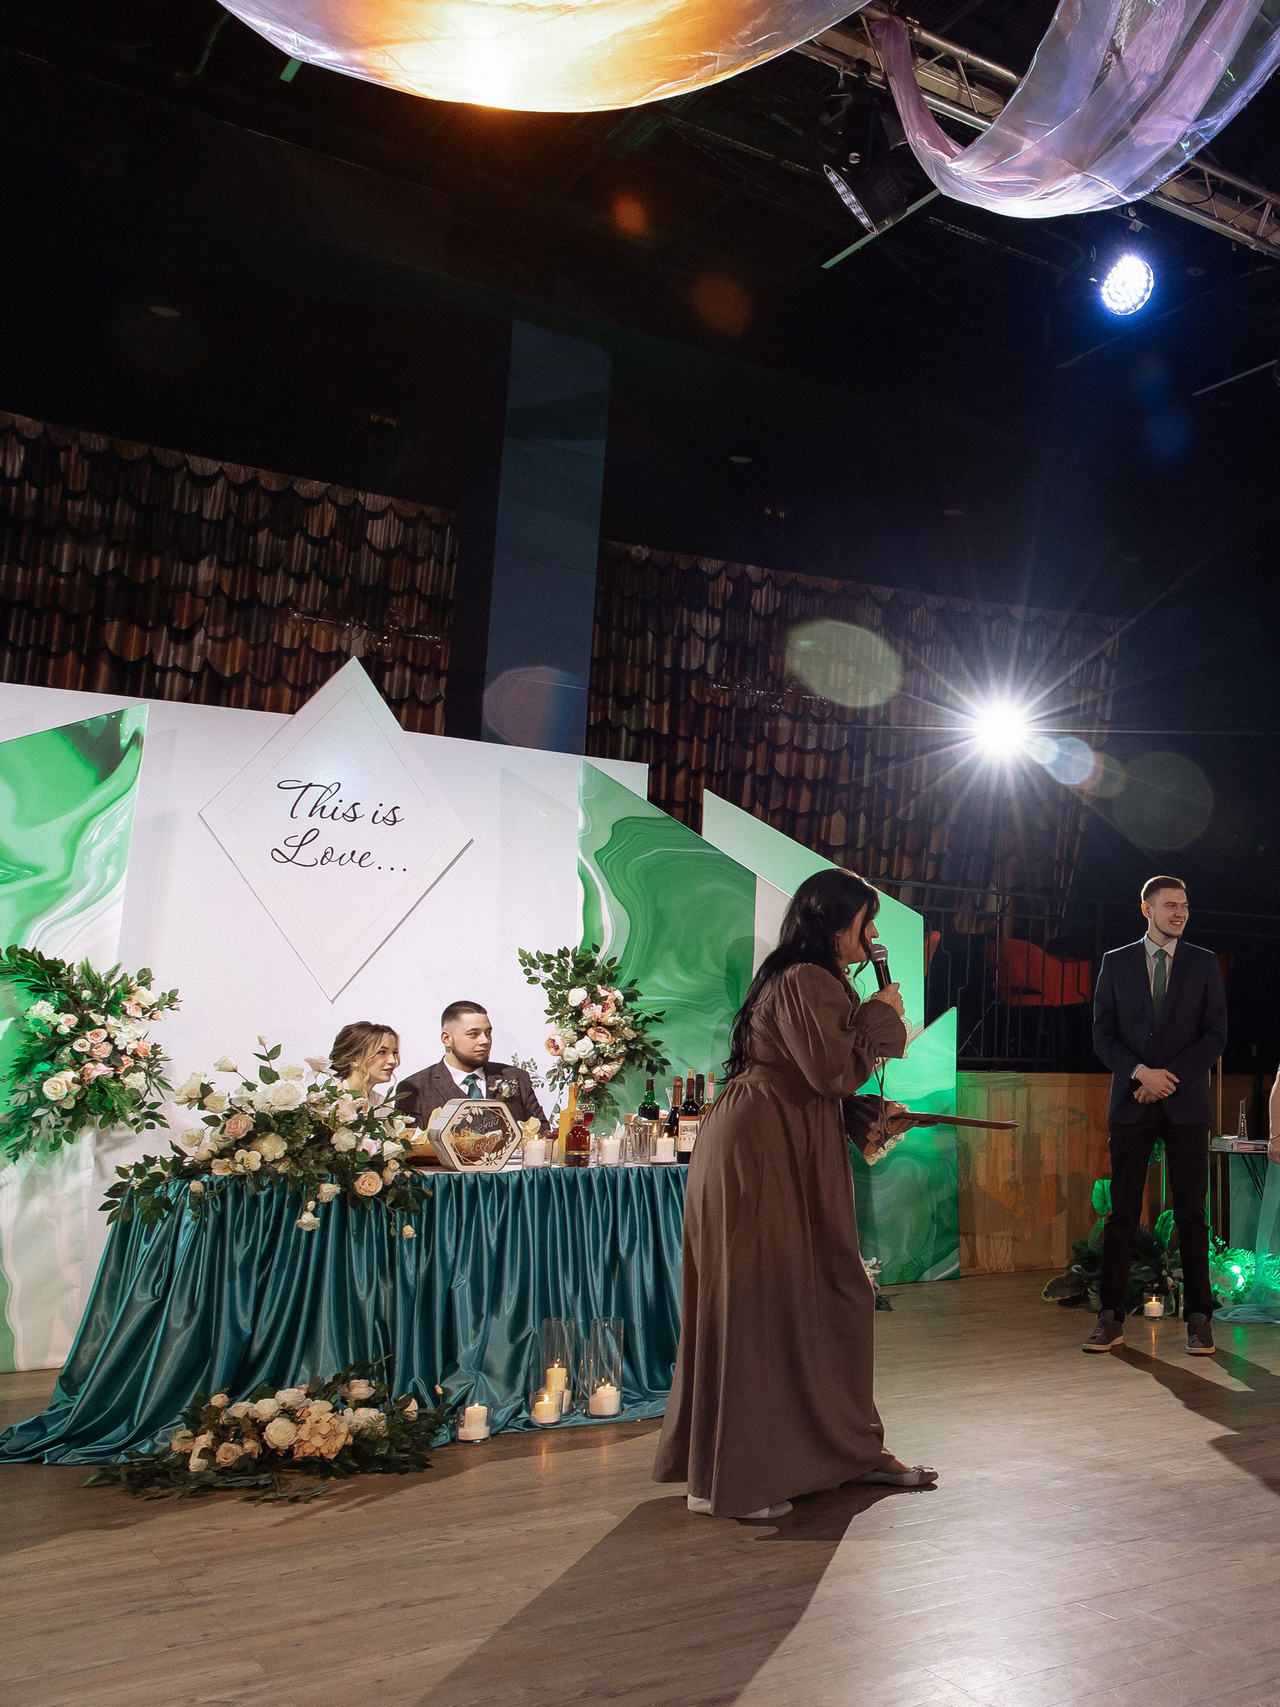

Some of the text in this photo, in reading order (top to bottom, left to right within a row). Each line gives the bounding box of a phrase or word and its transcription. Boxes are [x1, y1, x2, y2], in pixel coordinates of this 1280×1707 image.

[277, 779, 405, 826] This is
[270, 828, 407, 872] Love...
